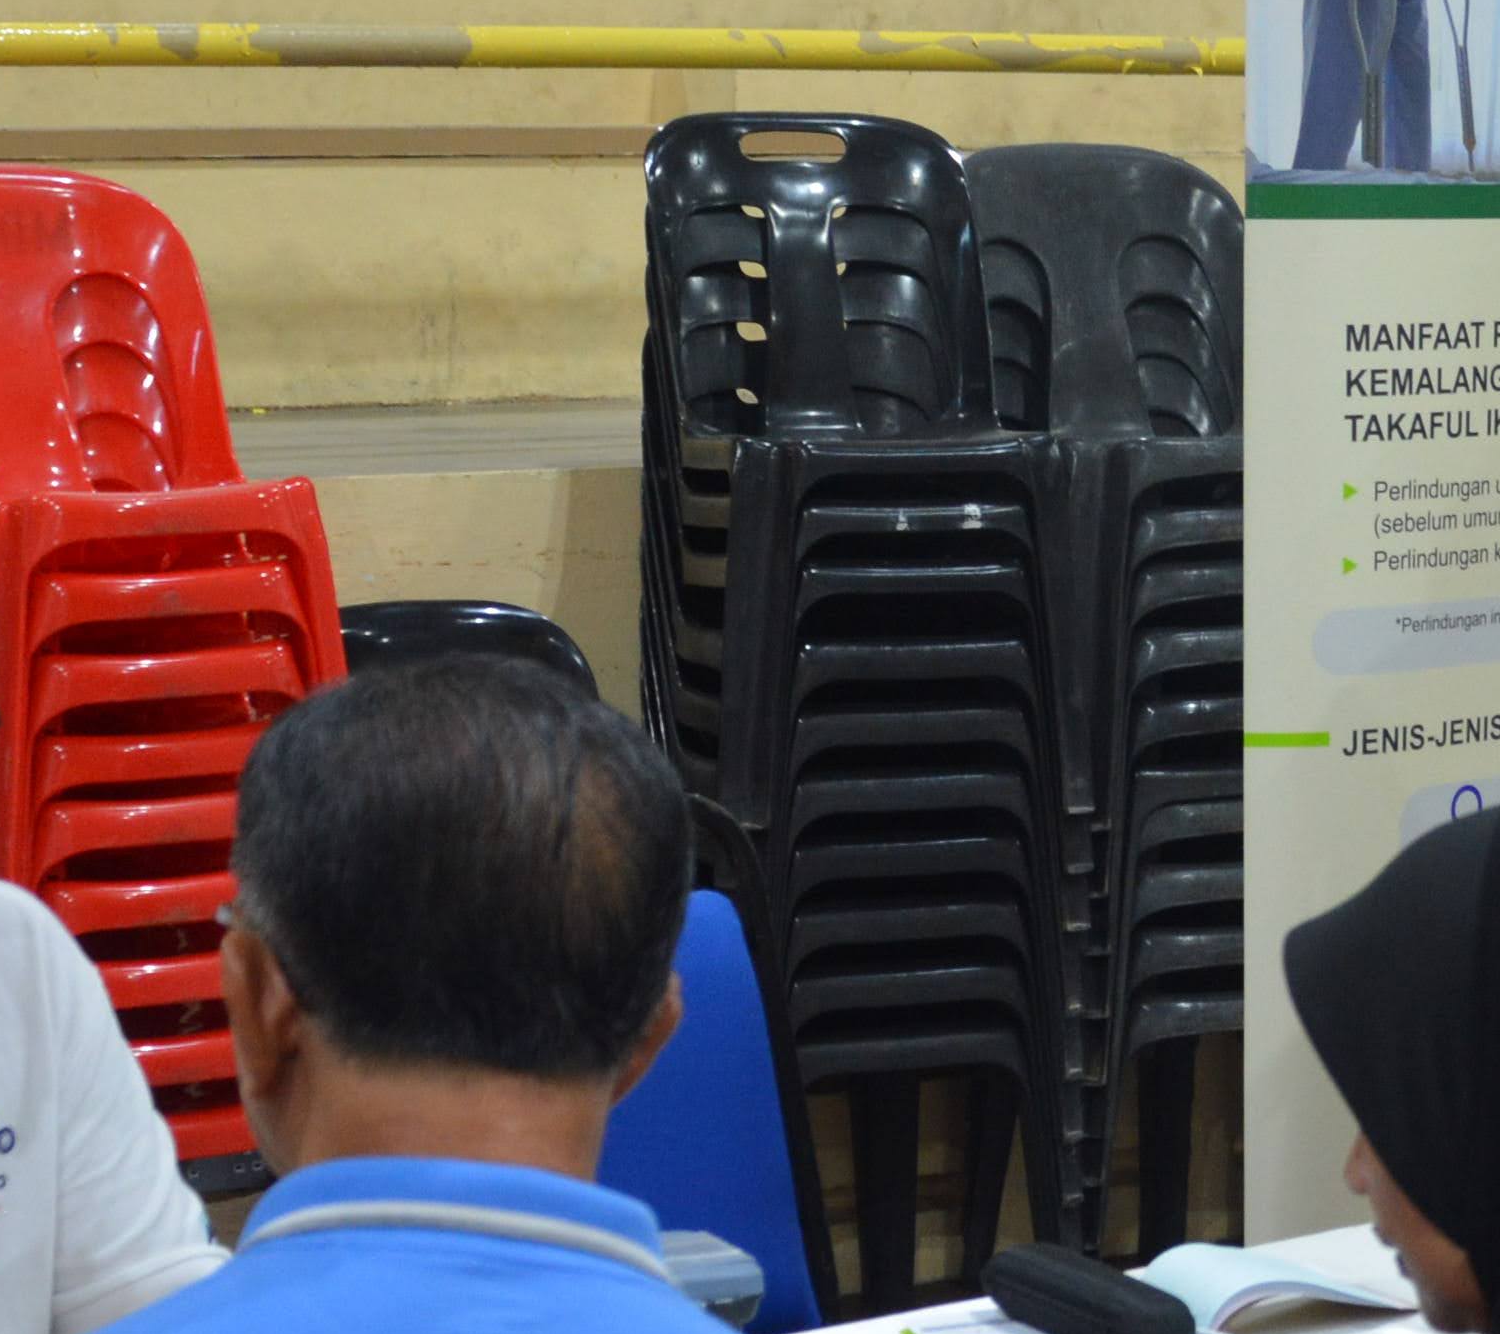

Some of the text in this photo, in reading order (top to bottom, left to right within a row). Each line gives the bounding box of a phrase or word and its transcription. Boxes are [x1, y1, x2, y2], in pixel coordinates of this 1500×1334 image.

[1345, 322, 1486, 352] MANFAAT
[1345, 410, 1479, 443] TAKAFUL
[1373, 477, 1491, 502] Perlindungan
[1373, 511, 1459, 540] (sebelum
[1373, 544, 1490, 572] Perlindungan
